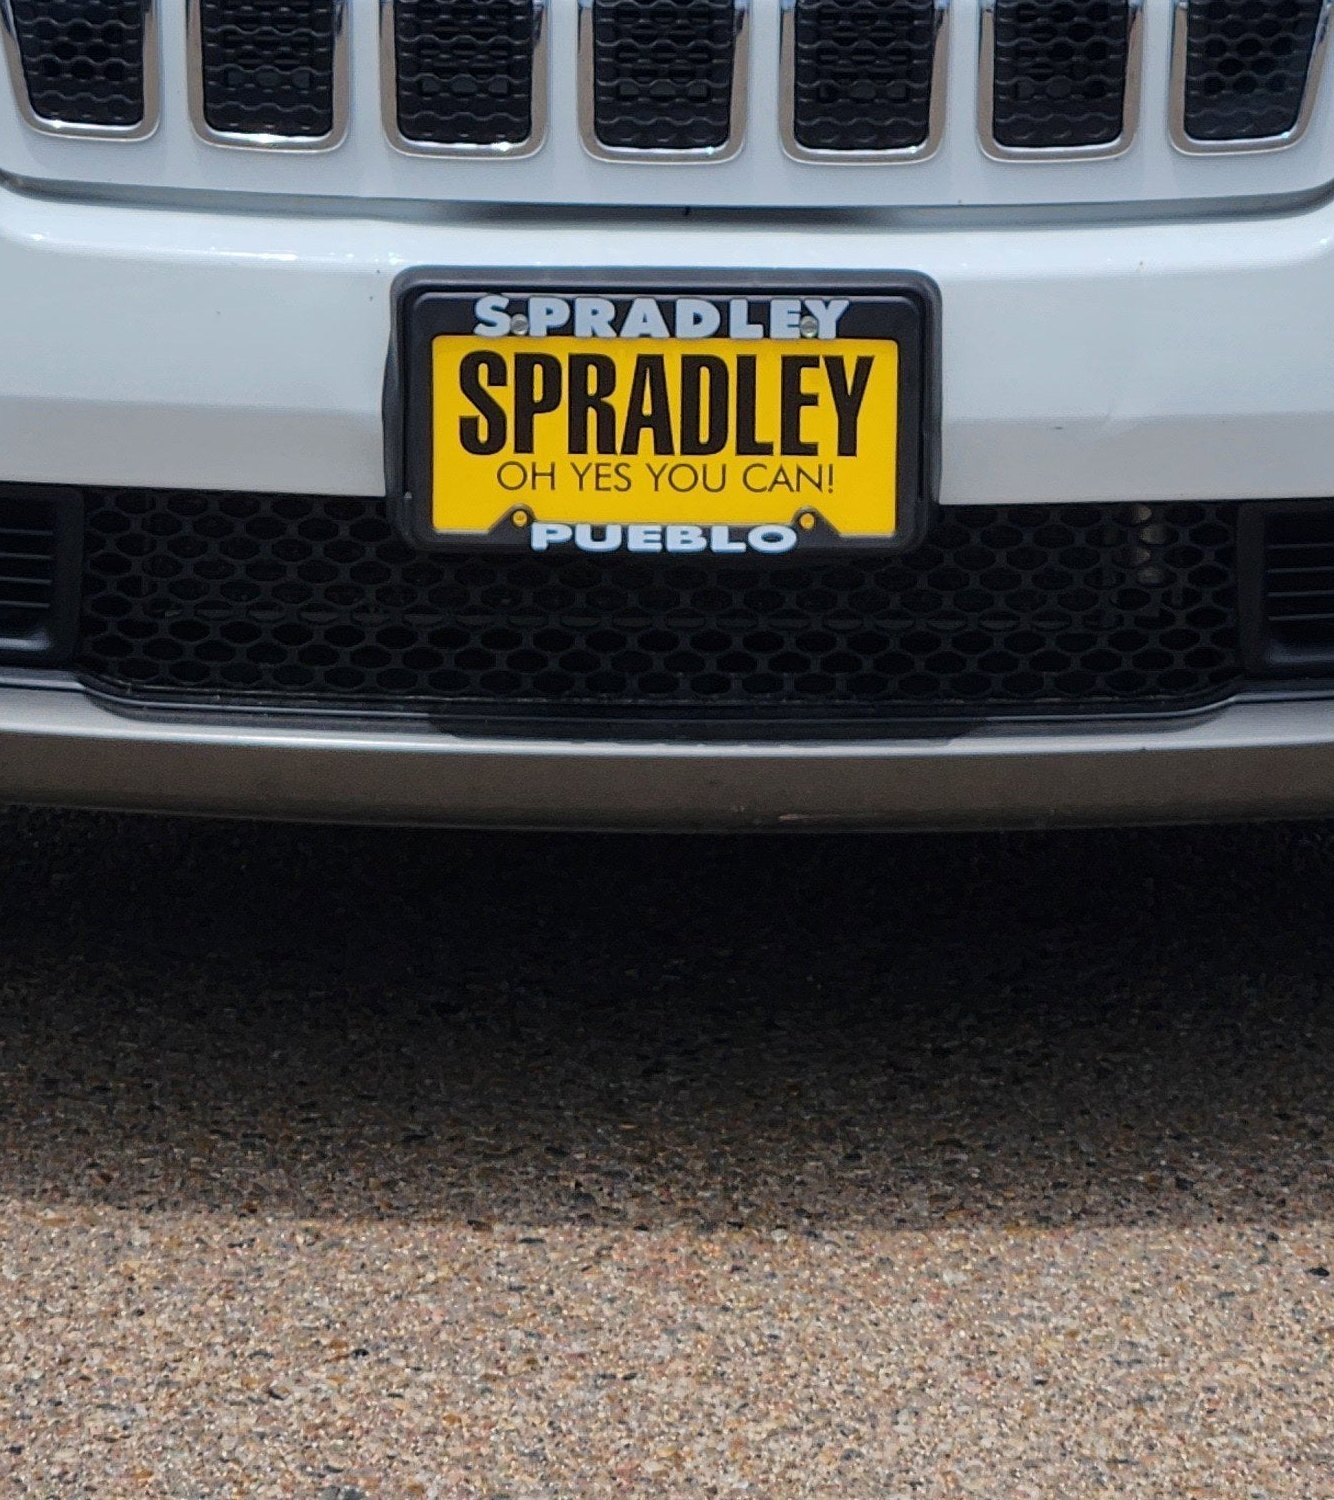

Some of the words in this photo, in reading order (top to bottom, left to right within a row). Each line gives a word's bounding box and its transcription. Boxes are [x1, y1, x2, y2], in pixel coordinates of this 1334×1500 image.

[472, 294, 850, 339] SPRADLEY
[458, 350, 876, 458] SPRADLEY
[496, 461, 556, 492] OH
[570, 462, 632, 493] YES
[645, 463, 728, 493] YOU
[742, 463, 836, 494] CAN!
[530, 522, 798, 554] PUEBLO
